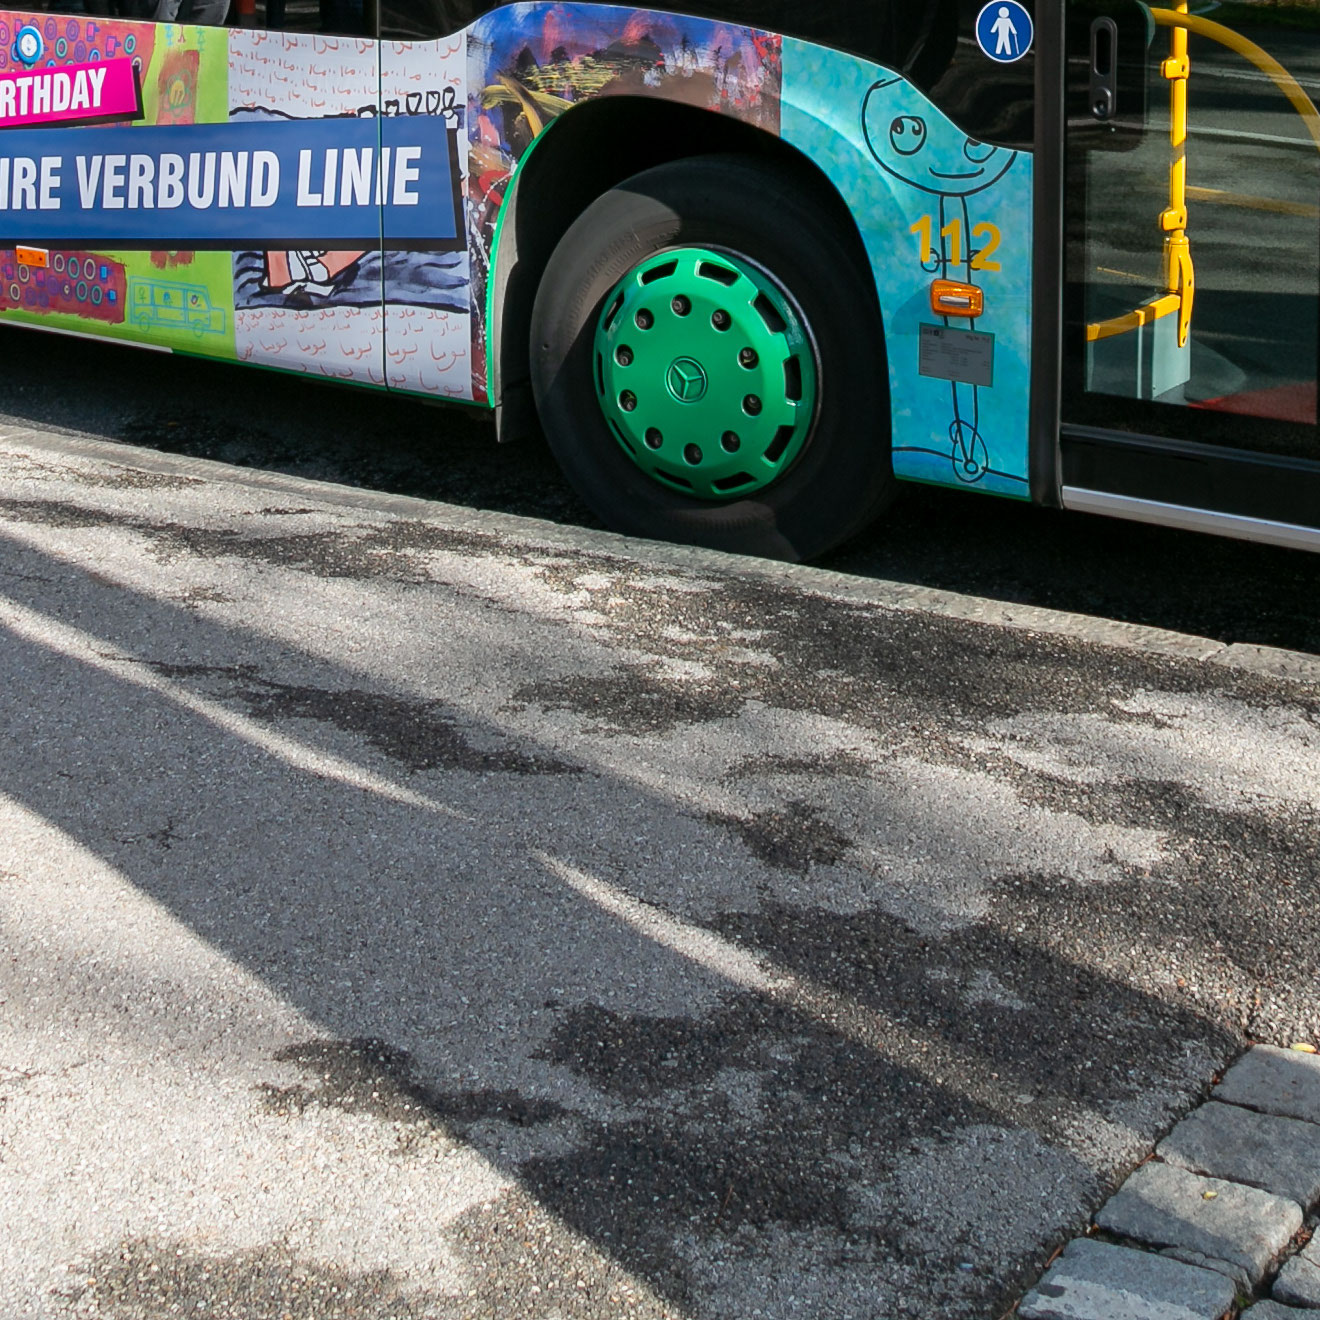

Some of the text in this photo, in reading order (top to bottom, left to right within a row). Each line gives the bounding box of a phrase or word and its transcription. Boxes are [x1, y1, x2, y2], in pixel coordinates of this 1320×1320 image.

[77, 149, 281, 211] VERBUND
[296, 145, 423, 208] LINIE
[910, 215, 1001, 271] 112
